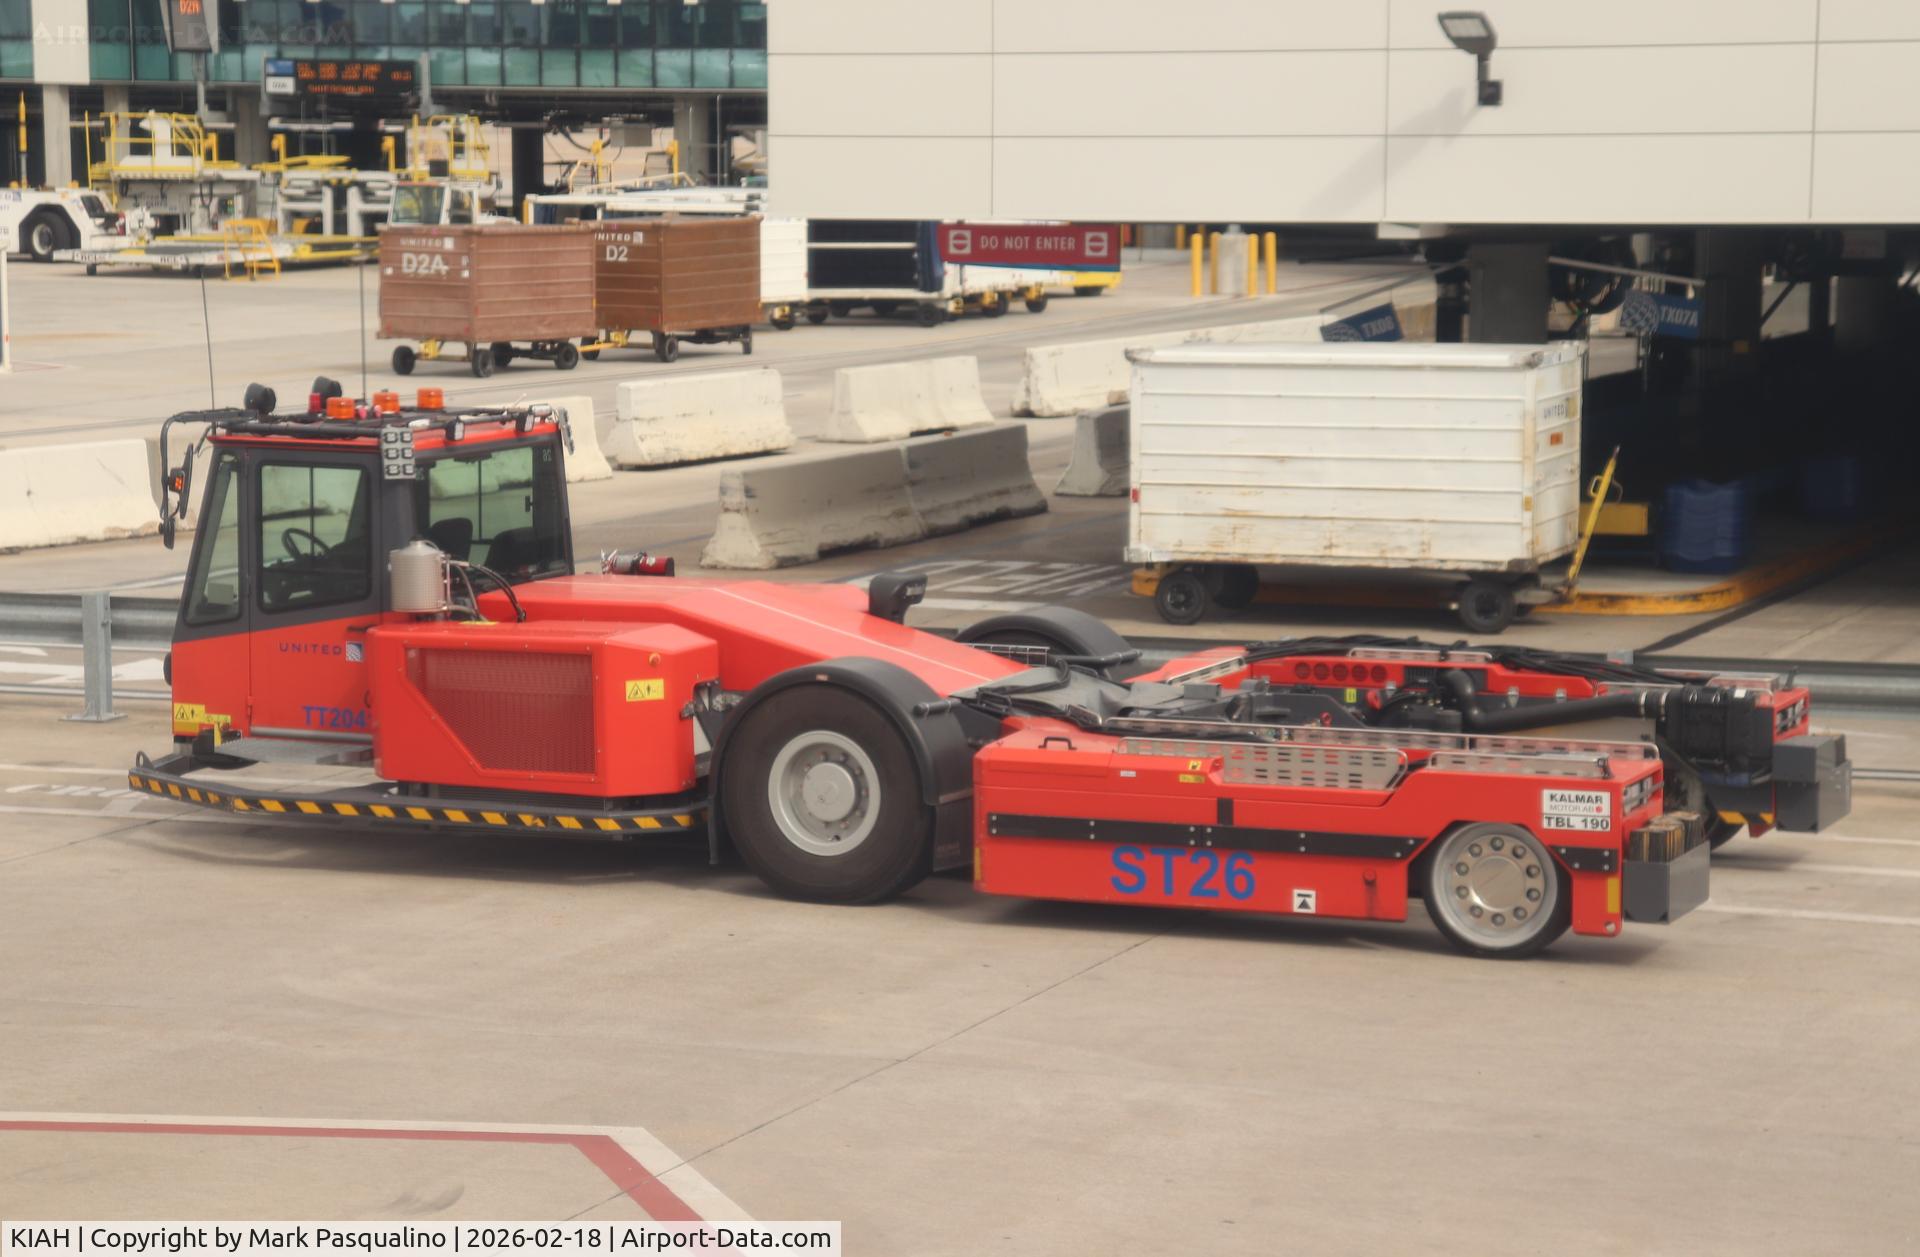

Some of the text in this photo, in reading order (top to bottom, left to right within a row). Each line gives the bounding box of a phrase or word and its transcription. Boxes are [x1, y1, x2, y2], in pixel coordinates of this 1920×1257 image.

[981, 236, 1075, 250] DO NOT ENTER
[606, 245, 628, 262] D2
[402, 253, 446, 273] D2A
[279, 643, 342, 655] UNITED
[1549, 793, 1603, 804] KALMAR
[1549, 804, 1580, 812] MOTOR
[1544, 816, 1609, 830] TBL 190
[1111, 846, 1255, 900] ST26
